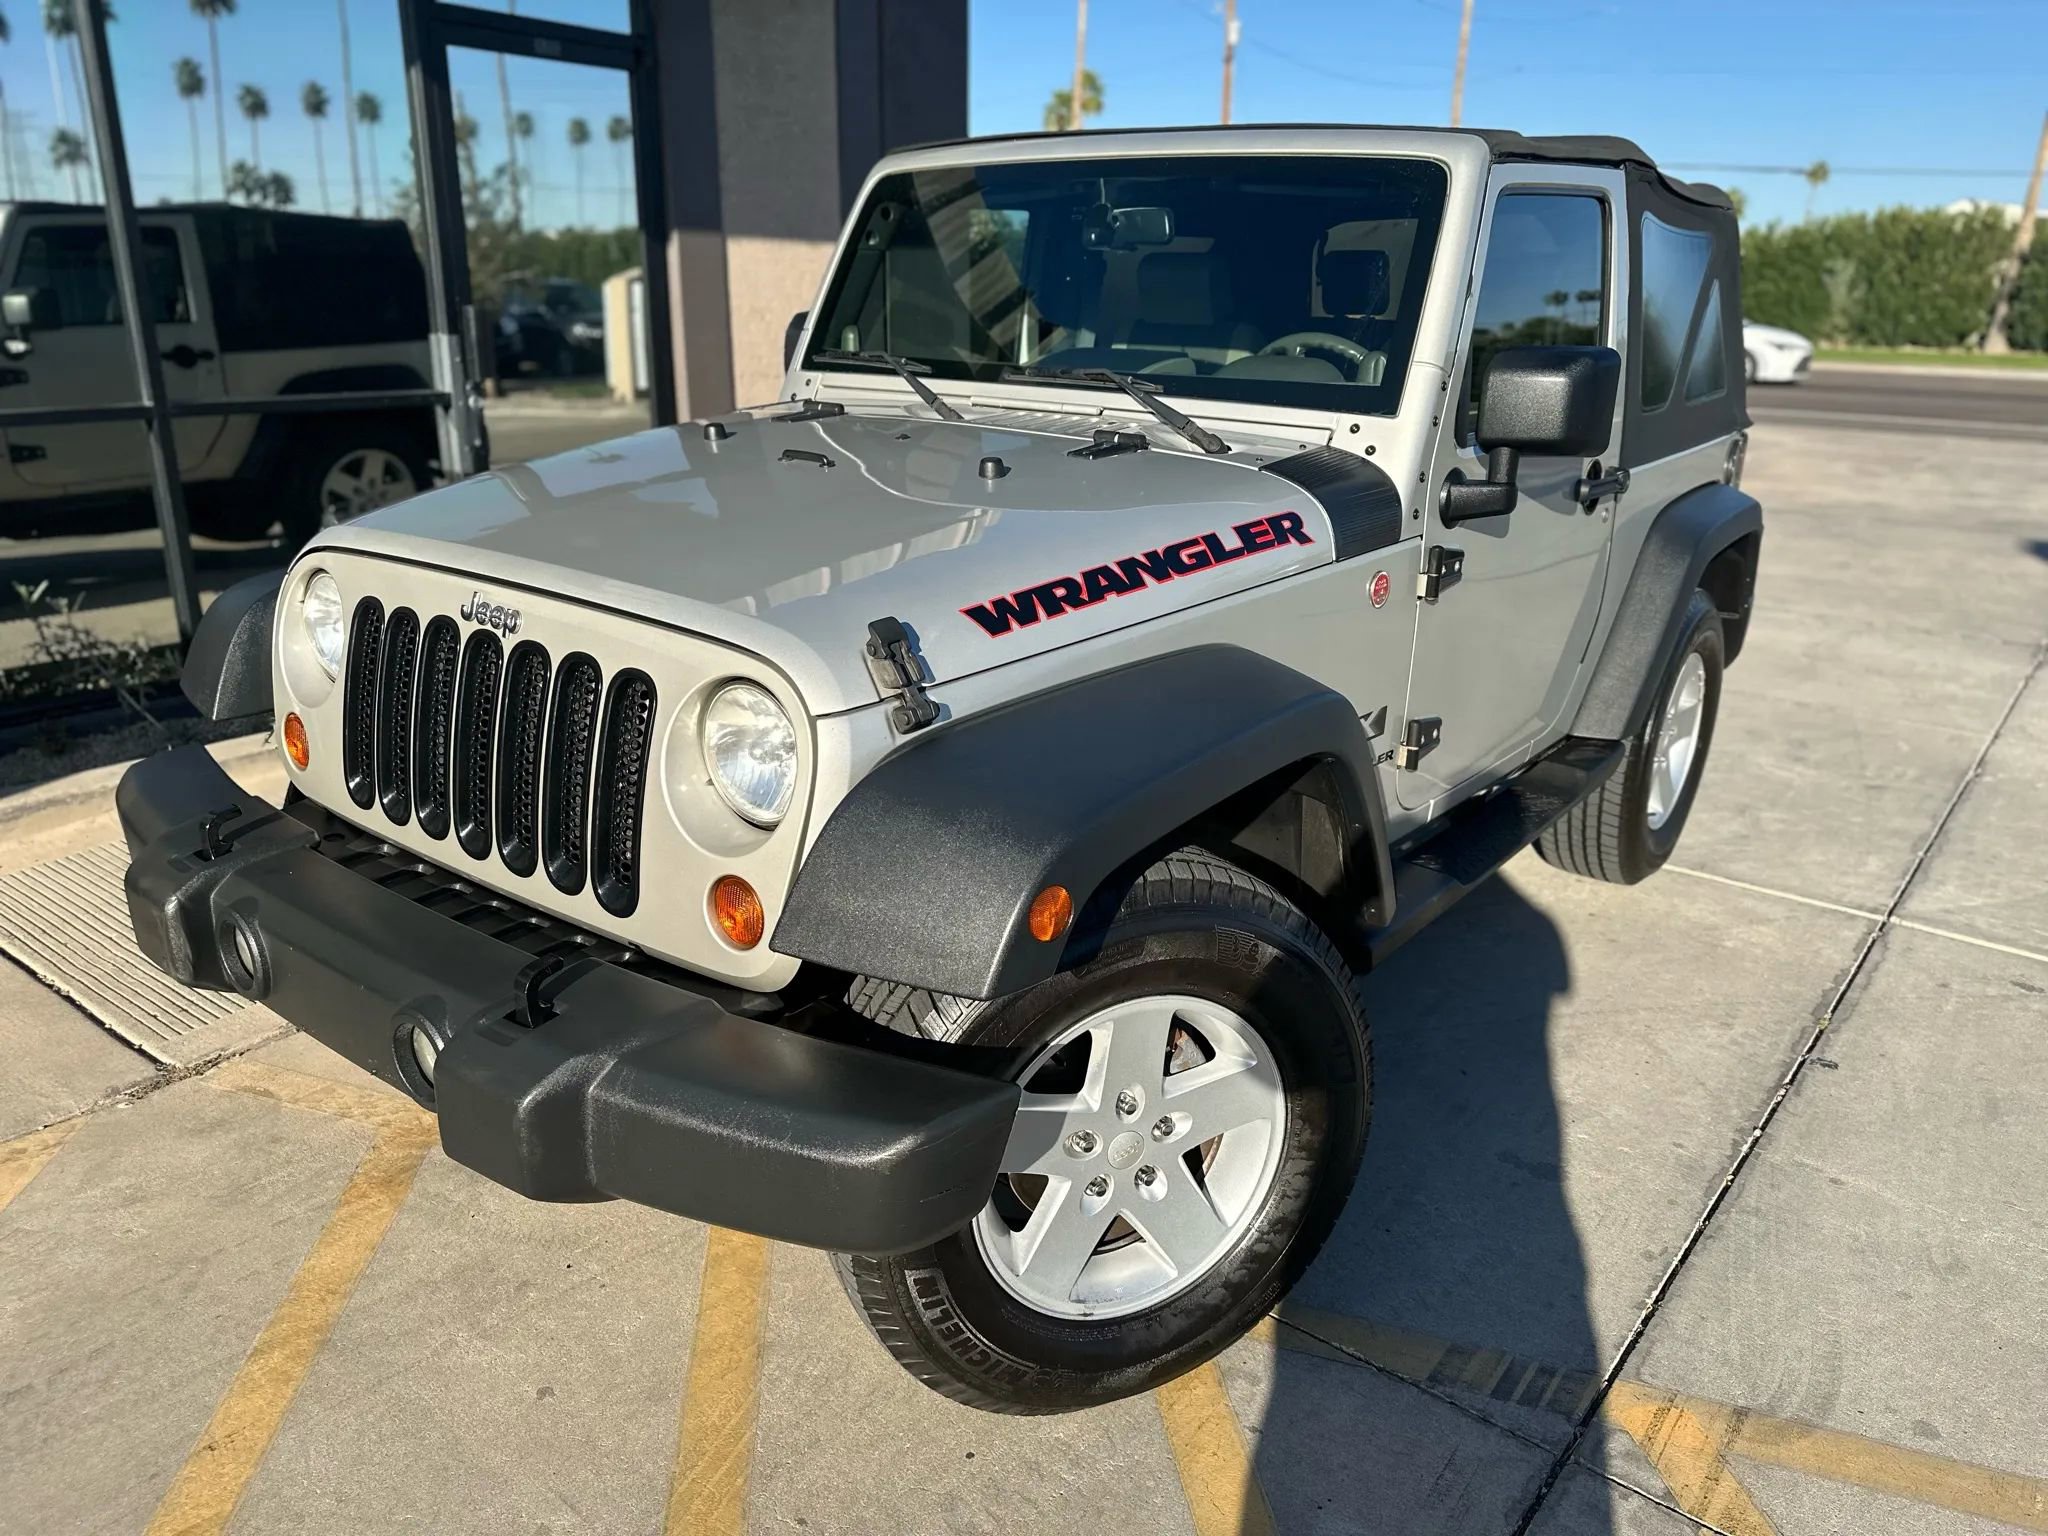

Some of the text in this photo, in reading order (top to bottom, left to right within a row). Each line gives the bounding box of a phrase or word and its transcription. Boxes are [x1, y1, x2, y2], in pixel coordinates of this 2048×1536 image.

[461, 591, 522, 639] Jeep
[960, 511, 1315, 637] WRANGLER
[909, 1272, 1032, 1386] MICHELIN
